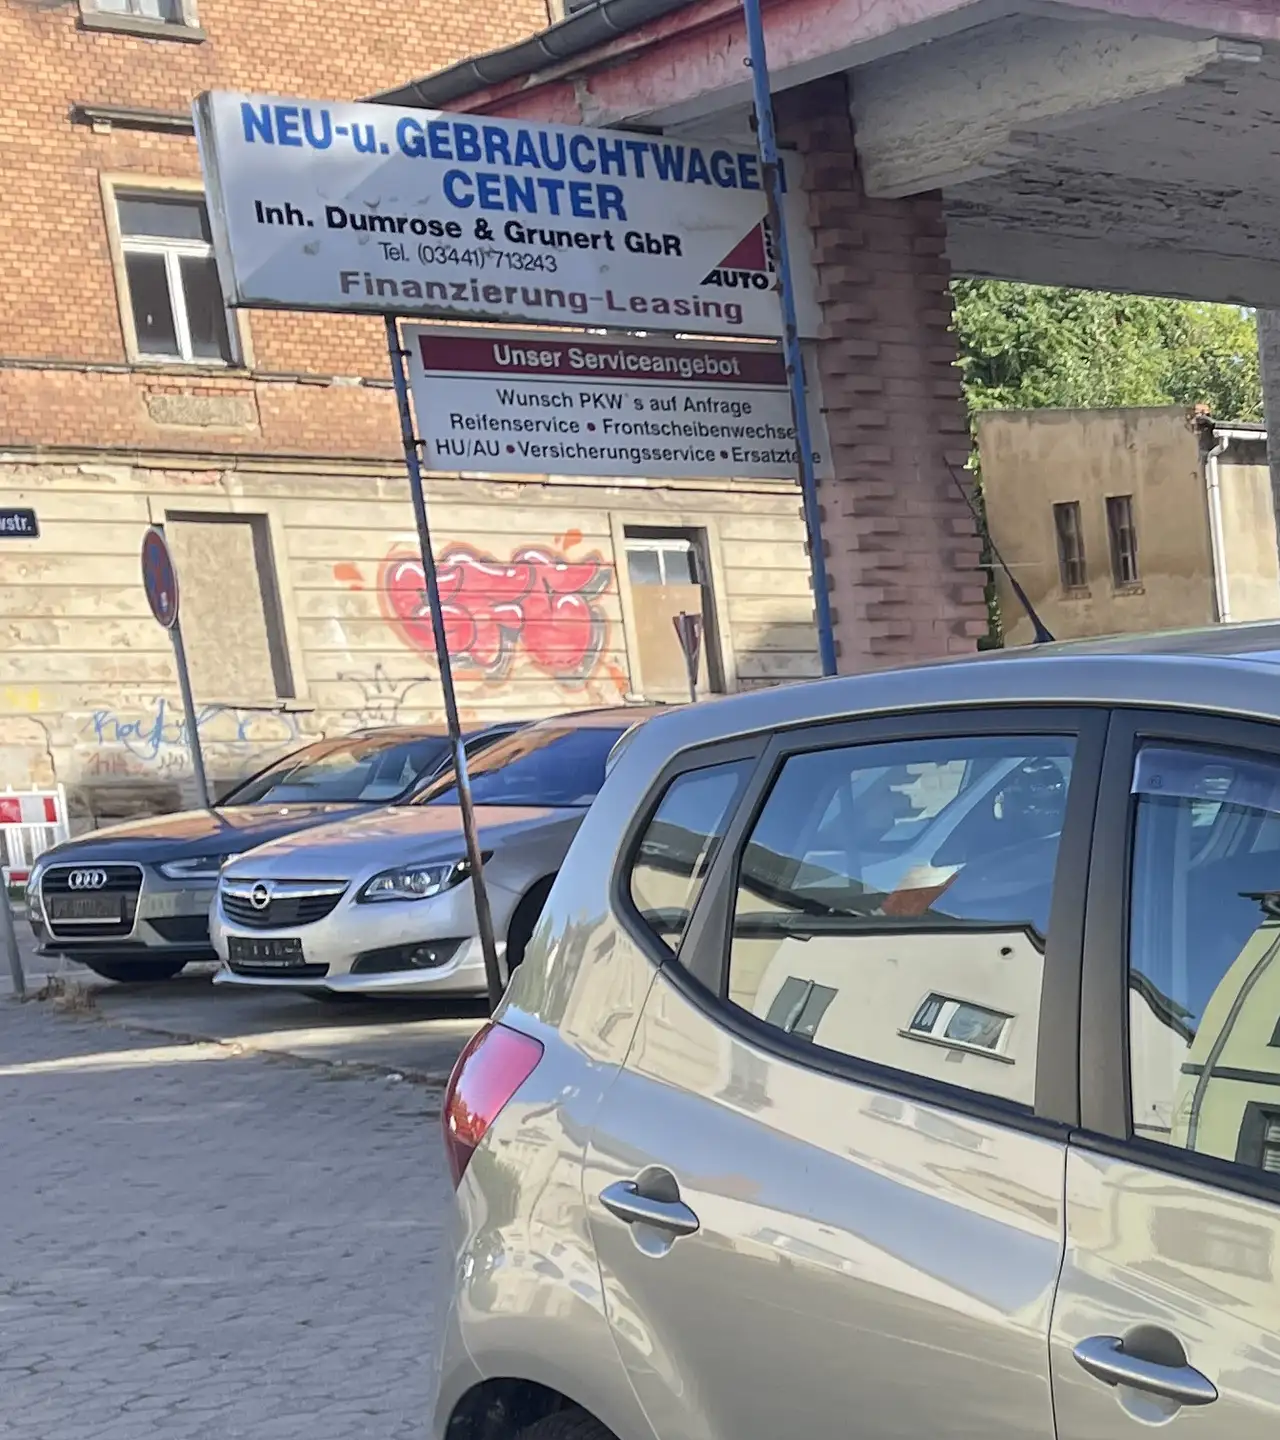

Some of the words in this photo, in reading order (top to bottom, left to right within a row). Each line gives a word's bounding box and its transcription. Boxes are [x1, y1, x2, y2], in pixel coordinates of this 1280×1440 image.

[240, 102, 389, 154] NEU-u.
[396, 117, 788, 194] GEBRAUCHTWAGE
[442, 169, 628, 221] CENTER
[254, 200, 314, 227] Inh.
[325, 205, 462, 238] Dumrose
[474, 217, 495, 242] &
[504, 220, 615, 252] Grunert
[624, 231, 683, 257] GbR
[378, 242, 410, 262] Tel.
[418, 243, 485, 269] (03441)
[492, 250, 558, 274] 713243
[700, 269, 769, 290] AUTO
[493, 343, 562, 369] Unser
[567, 347, 741, 378] Serviceangebot
[496, 388, 573, 408] Wunsch
[650, 396, 677, 411] auf
[684, 396, 752, 417] Anfrage
[450, 413, 580, 433] Reifenservice
[603, 418, 797, 440] Frontscheibenwechse
[436, 438, 500, 458] HU/AU
[517, 440, 715, 463] Versicherungsservice
[732, 447, 821, 464] Ersatztee
